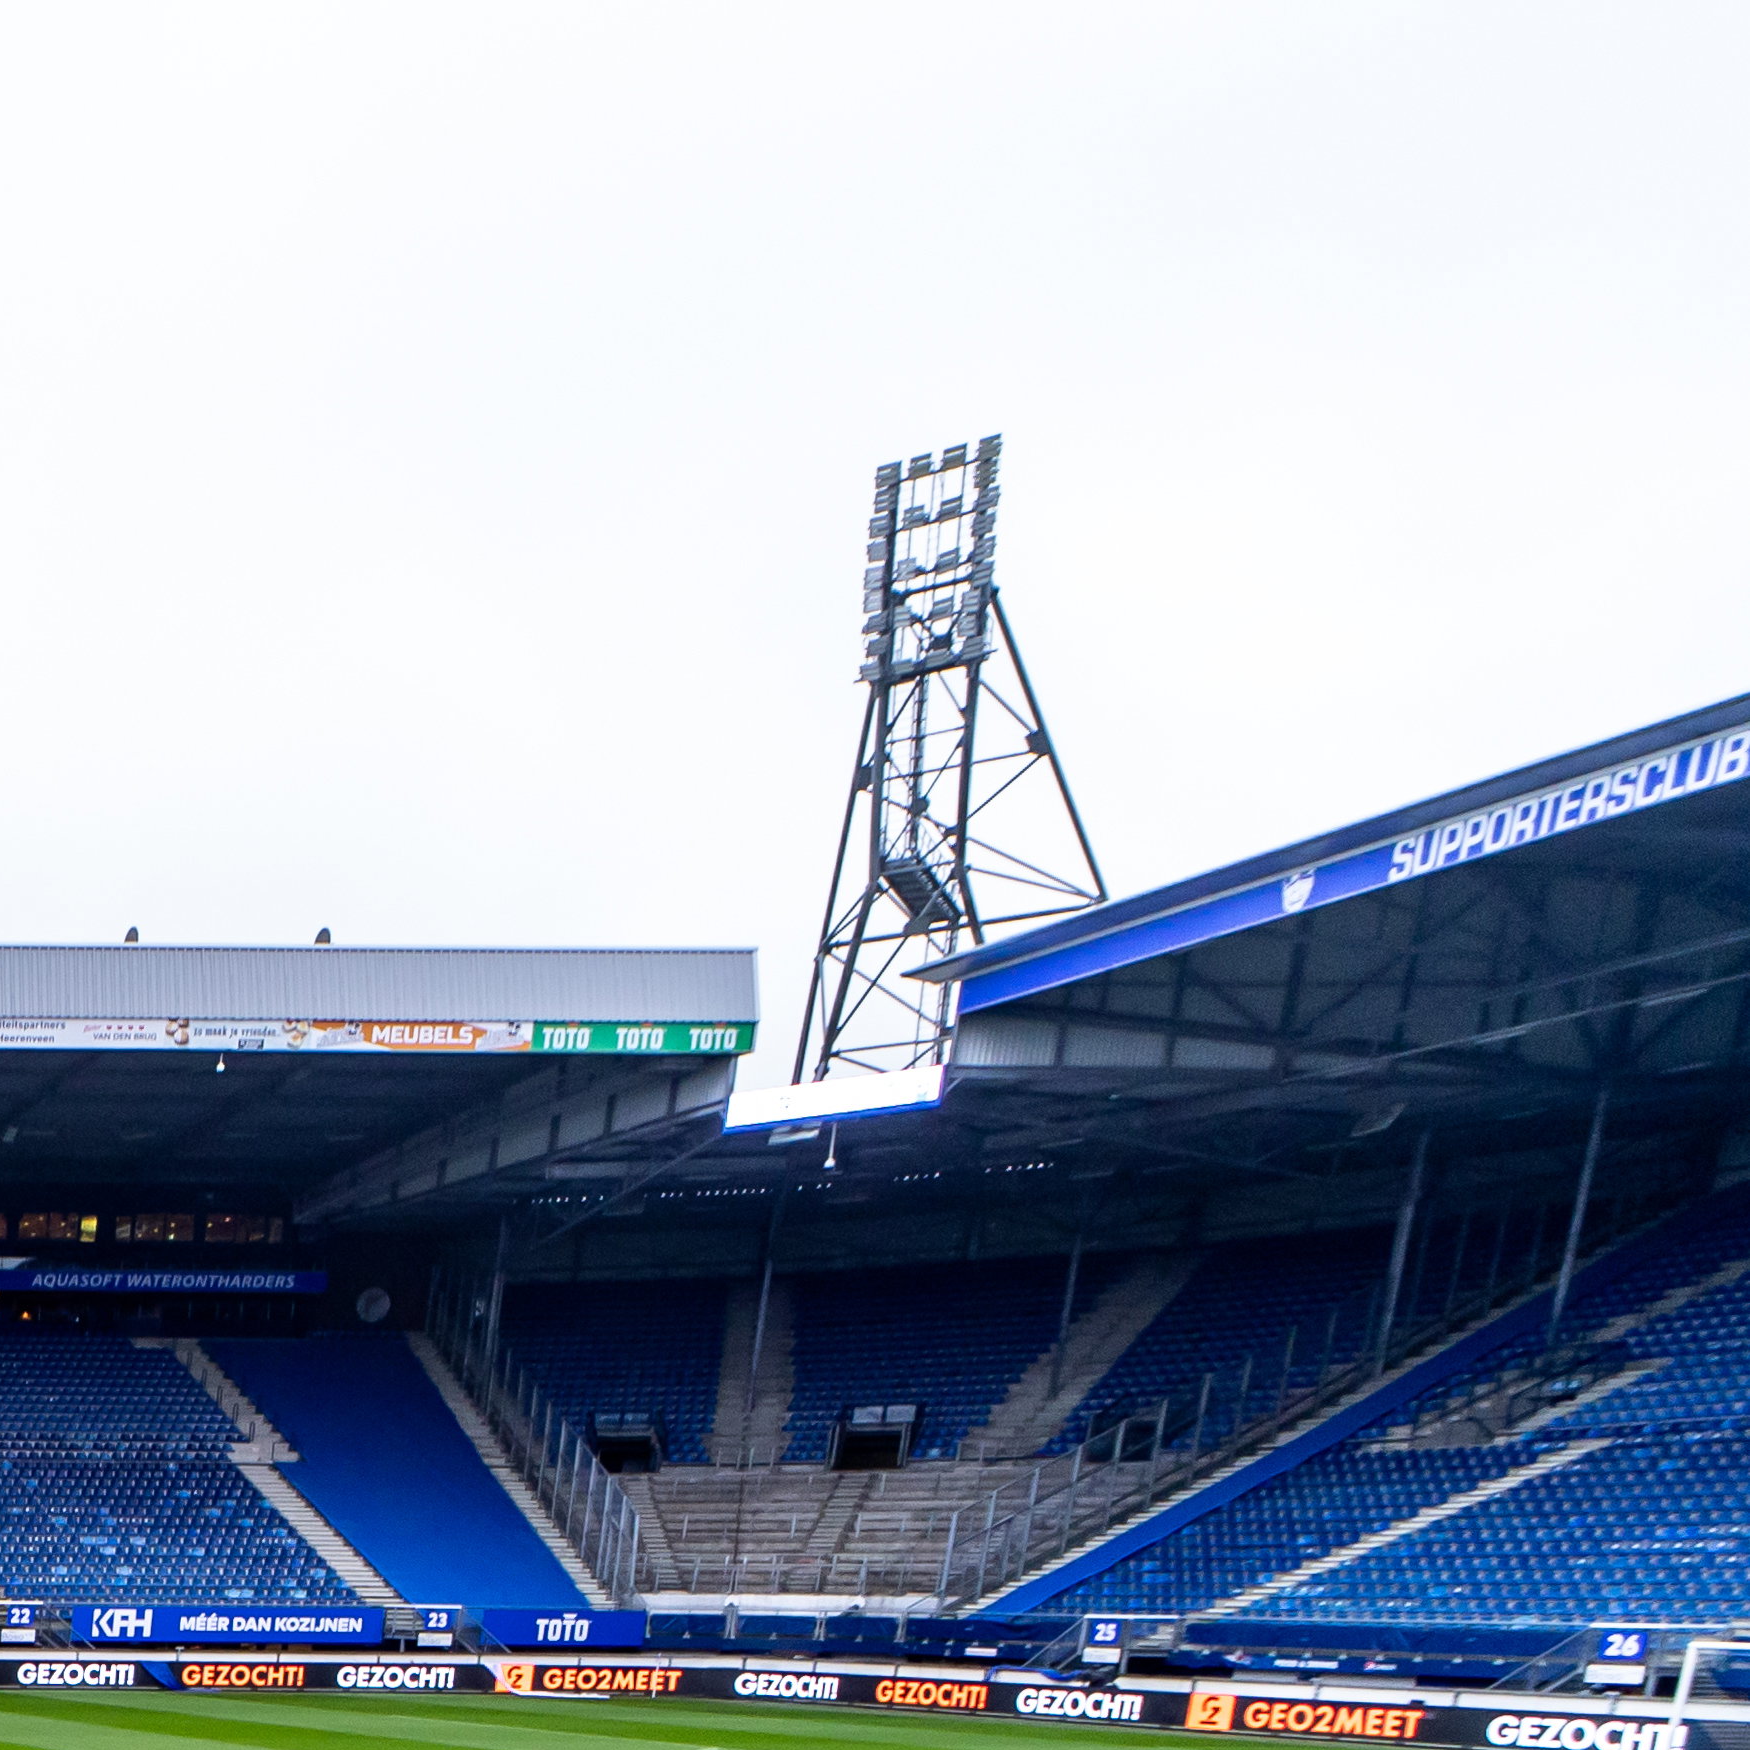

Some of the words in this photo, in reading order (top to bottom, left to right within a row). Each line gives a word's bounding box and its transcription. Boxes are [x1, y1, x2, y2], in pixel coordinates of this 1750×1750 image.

[1389, 733, 1750, 882] SUPPORTERSCLUB
[369, 1024, 474, 1047] MEUBELS
[542, 1027, 592, 1050] TOTO
[616, 1027, 666, 1050] TOTO
[689, 1027, 739, 1050] TOTO
[32, 1272, 125, 1288] AQUASOFT
[128, 1273, 296, 1289] WATERONTHARDERS
[10, 1607, 31, 1624] 22
[91, 1608, 154, 1638] KFH
[179, 1612, 230, 1633] MÉÉR
[232, 1616, 272, 1632] DAN
[274, 1616, 363, 1633] KOZIJNEN
[427, 1611, 448, 1628] 23
[536, 1616, 591, 1642] TOTO
[1094, 1622, 1117, 1642] 25
[1603, 1633, 1640, 1657] 26
[17, 1662, 135, 1686] GEZOCHT!
[181, 1664, 305, 1687] GEZOCHT!
[336, 1665, 456, 1689] GEZOCHT!
[542, 1667, 683, 1692] GEO2MEET
[733, 1672, 841, 1700] GEZOCHT!
[874, 1679, 990, 1710] GEZOCHT!
[1015, 1688, 1143, 1721] GEZOCHT!
[1243, 1701, 1424, 1739] GEO2MEET
